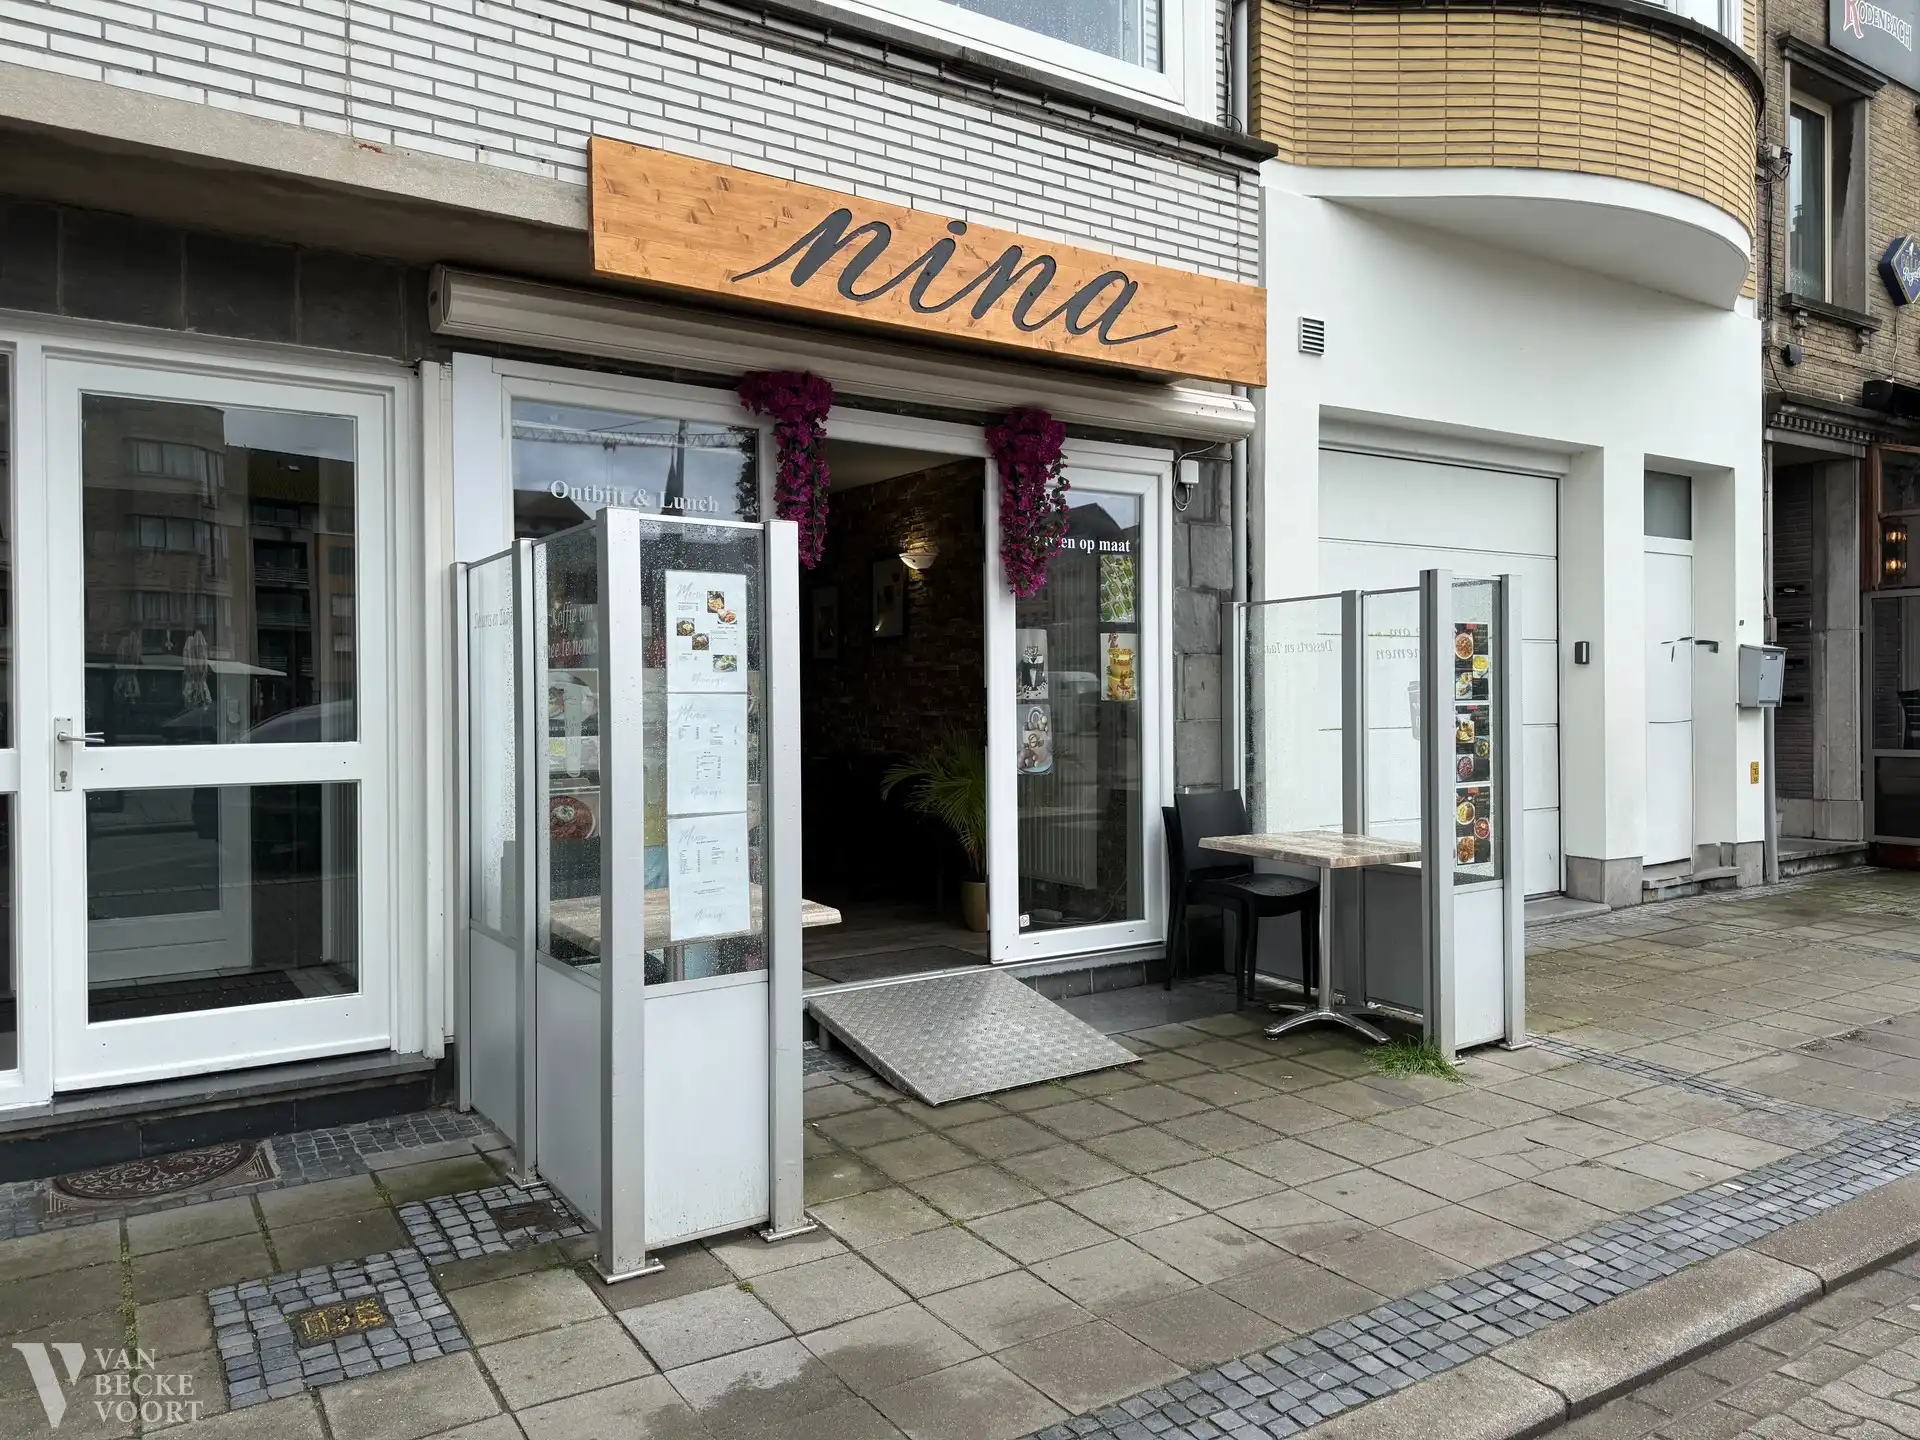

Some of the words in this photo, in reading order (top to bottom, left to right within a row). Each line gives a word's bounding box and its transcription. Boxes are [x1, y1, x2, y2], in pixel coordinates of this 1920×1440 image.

[1843, 0, 1912, 52] RODENBACH
[731, 207, 1178, 346] nina
[634, 488, 650, 507] &
[660, 490, 720, 512] Lunch
[1079, 538, 1095, 554] op
[1099, 539, 1131, 553] maat
